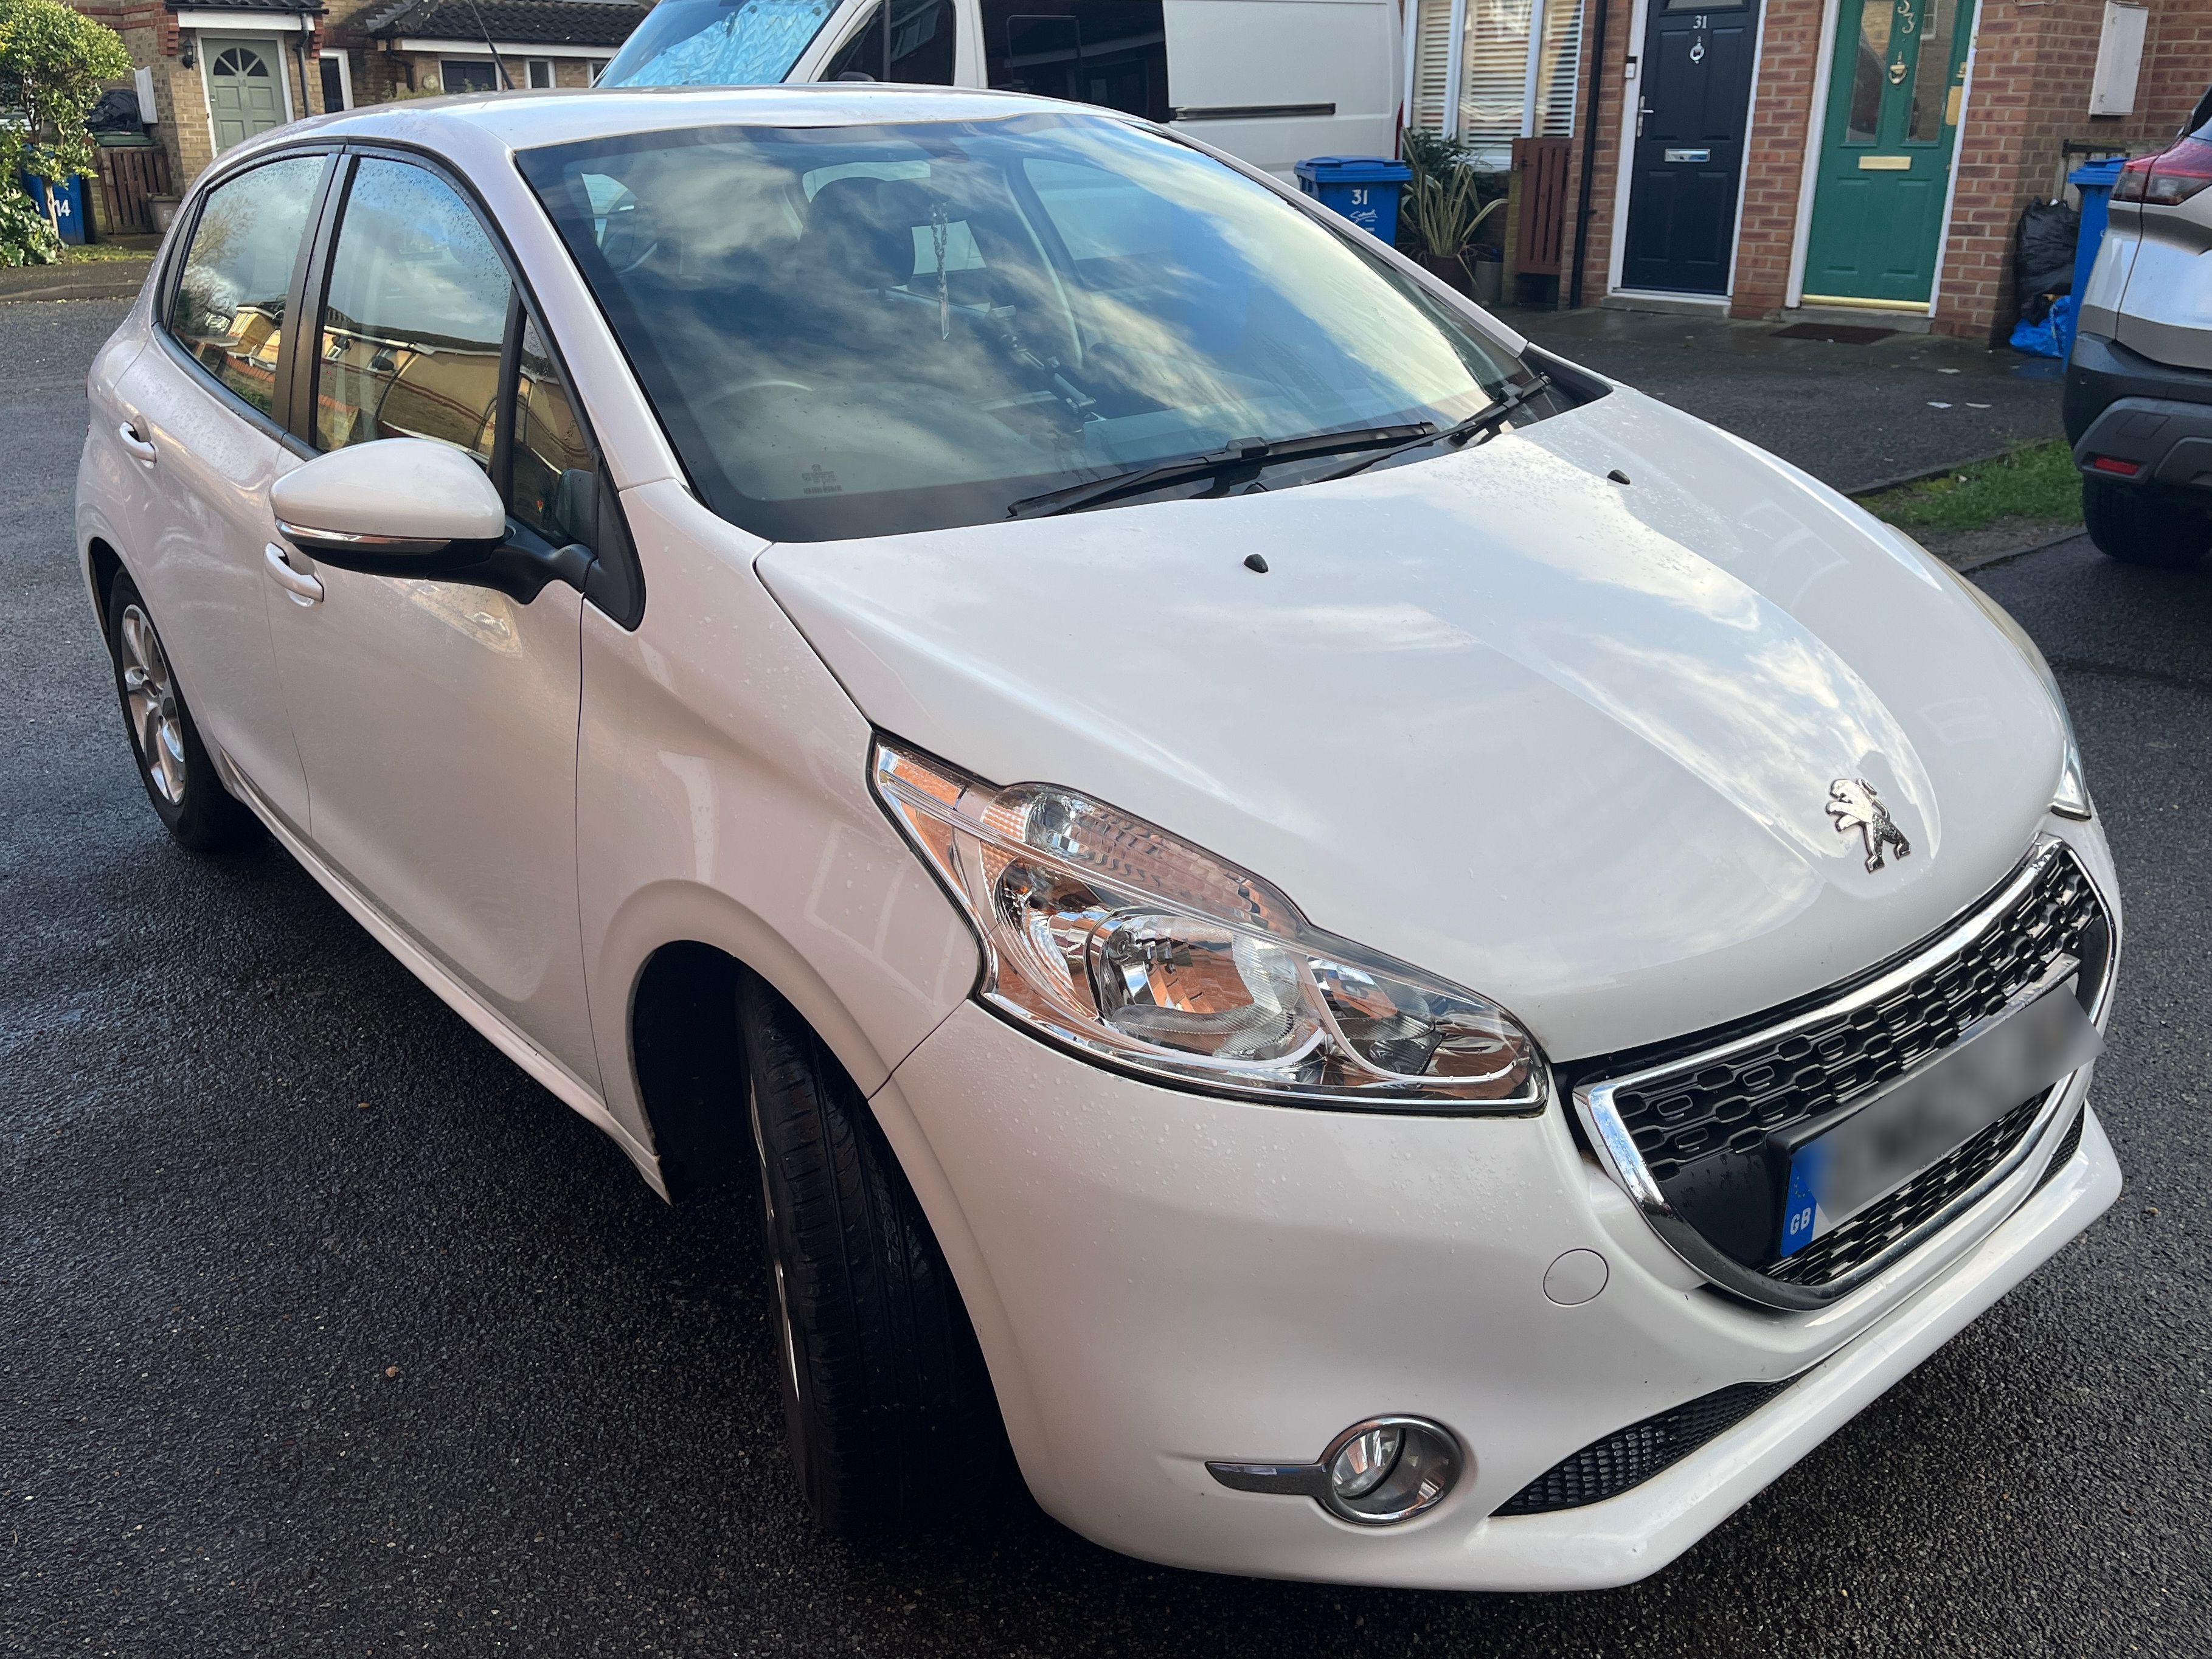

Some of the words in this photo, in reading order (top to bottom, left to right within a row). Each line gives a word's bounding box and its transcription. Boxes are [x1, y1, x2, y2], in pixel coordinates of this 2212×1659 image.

[1693, 15, 1707, 29] 31
[1351, 189, 1368, 205] 31
[54, 199, 71, 216] 14
[1790, 1207, 1811, 1235] GB
